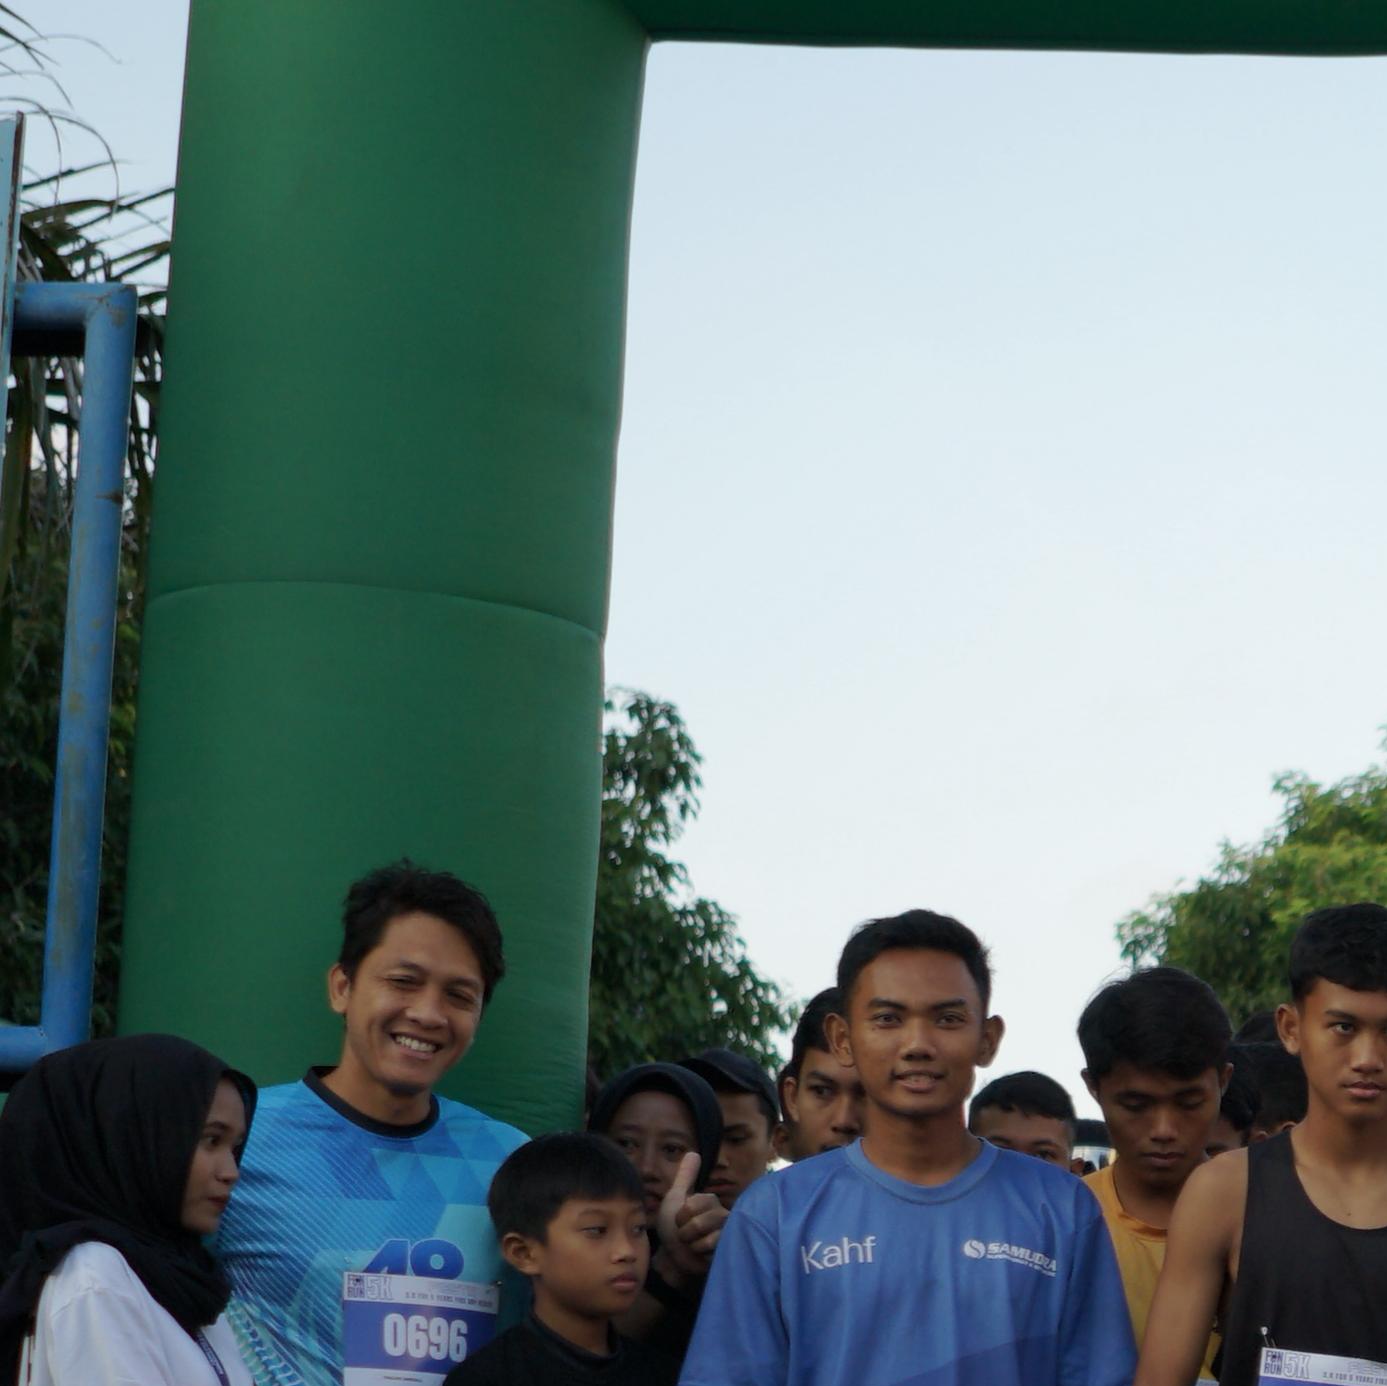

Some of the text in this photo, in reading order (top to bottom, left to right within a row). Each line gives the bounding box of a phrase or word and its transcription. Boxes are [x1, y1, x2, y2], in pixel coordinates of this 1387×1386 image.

[801, 1236, 876, 1274] Kahf
[987, 1241, 1057, 1272] SAMUDRA
[383, 1312, 468, 1363] 0696
